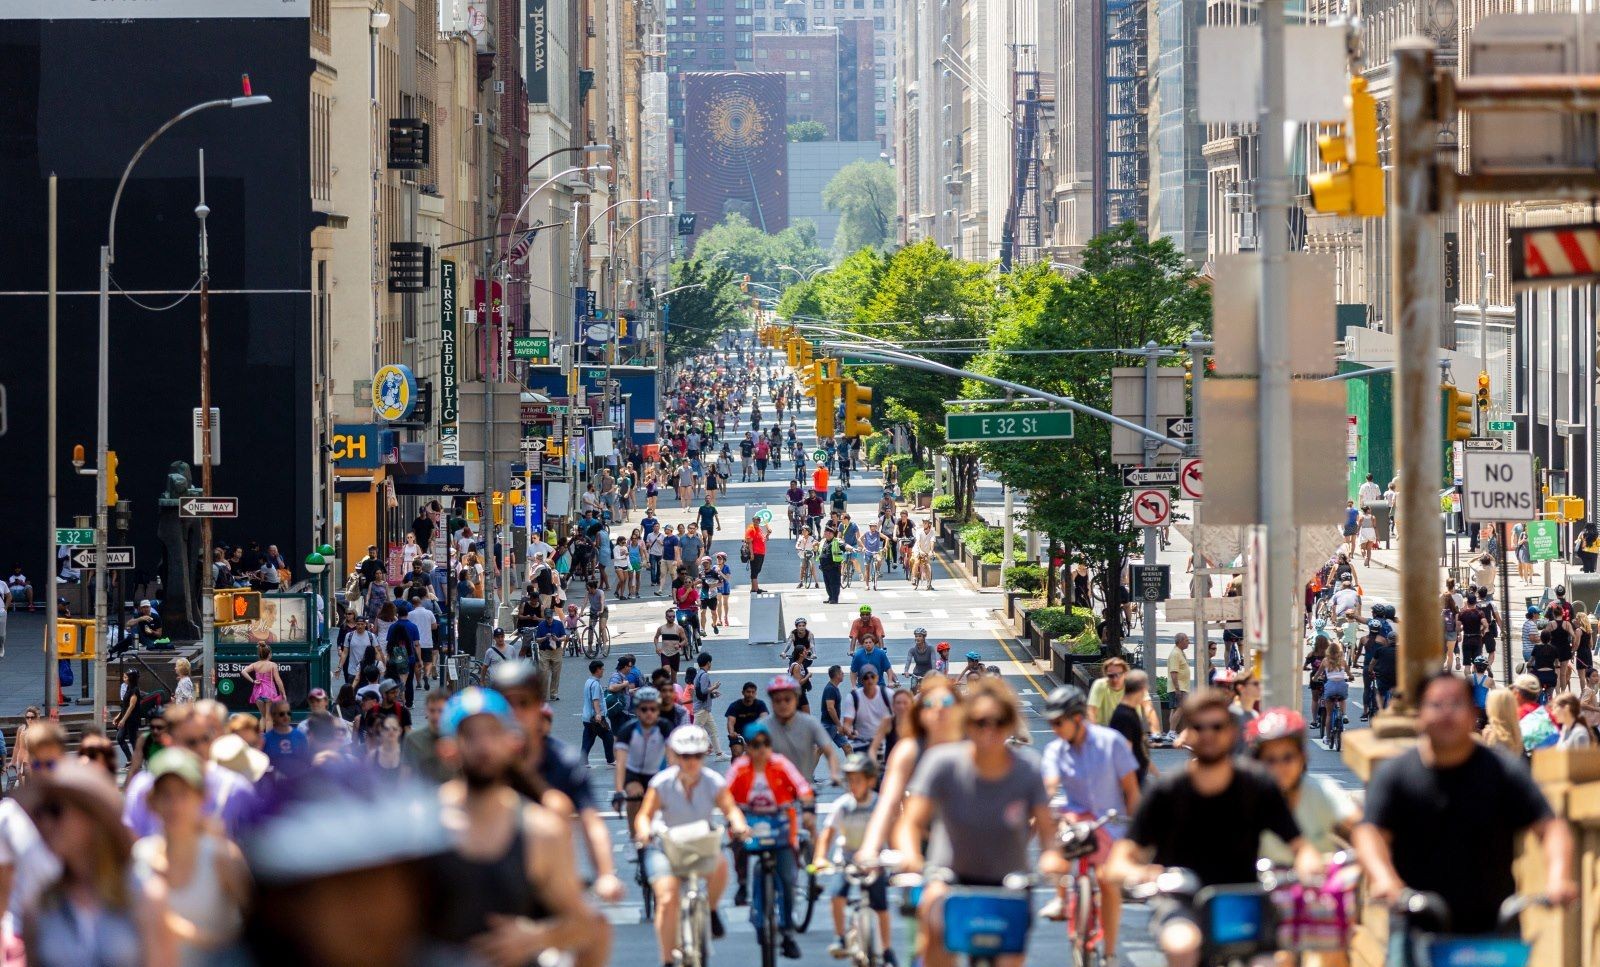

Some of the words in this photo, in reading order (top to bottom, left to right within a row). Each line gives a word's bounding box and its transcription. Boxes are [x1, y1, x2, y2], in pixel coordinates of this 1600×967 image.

[530, 6, 545, 72] wework
[682, 216, 694, 224] W
[443, 264, 453, 322] FIRST
[587, 291, 595, 316] NAILS
[442, 329, 454, 421] REPUBLIC
[982, 418, 991, 434] E
[997, 418, 1016, 434] 32
[1022, 417, 1038, 433] St
[1175, 423, 1193, 432] ONE
[333, 434, 366, 460] CH
[814, 452, 826, 460] GO
[1132, 473, 1148, 481] ONE
[1485, 463, 1513, 482] NO
[1470, 491, 1531, 509] TURNS
[188, 503, 205, 511] ONE
[212, 503, 230, 511] WAY
[56, 532, 62, 543] E
[66, 532, 81, 543] 32
[80, 554, 97, 563] ONE
[107, 553, 126, 562] WAY
[218, 663, 230, 672] 33
[222, 682, 230, 691] 6
